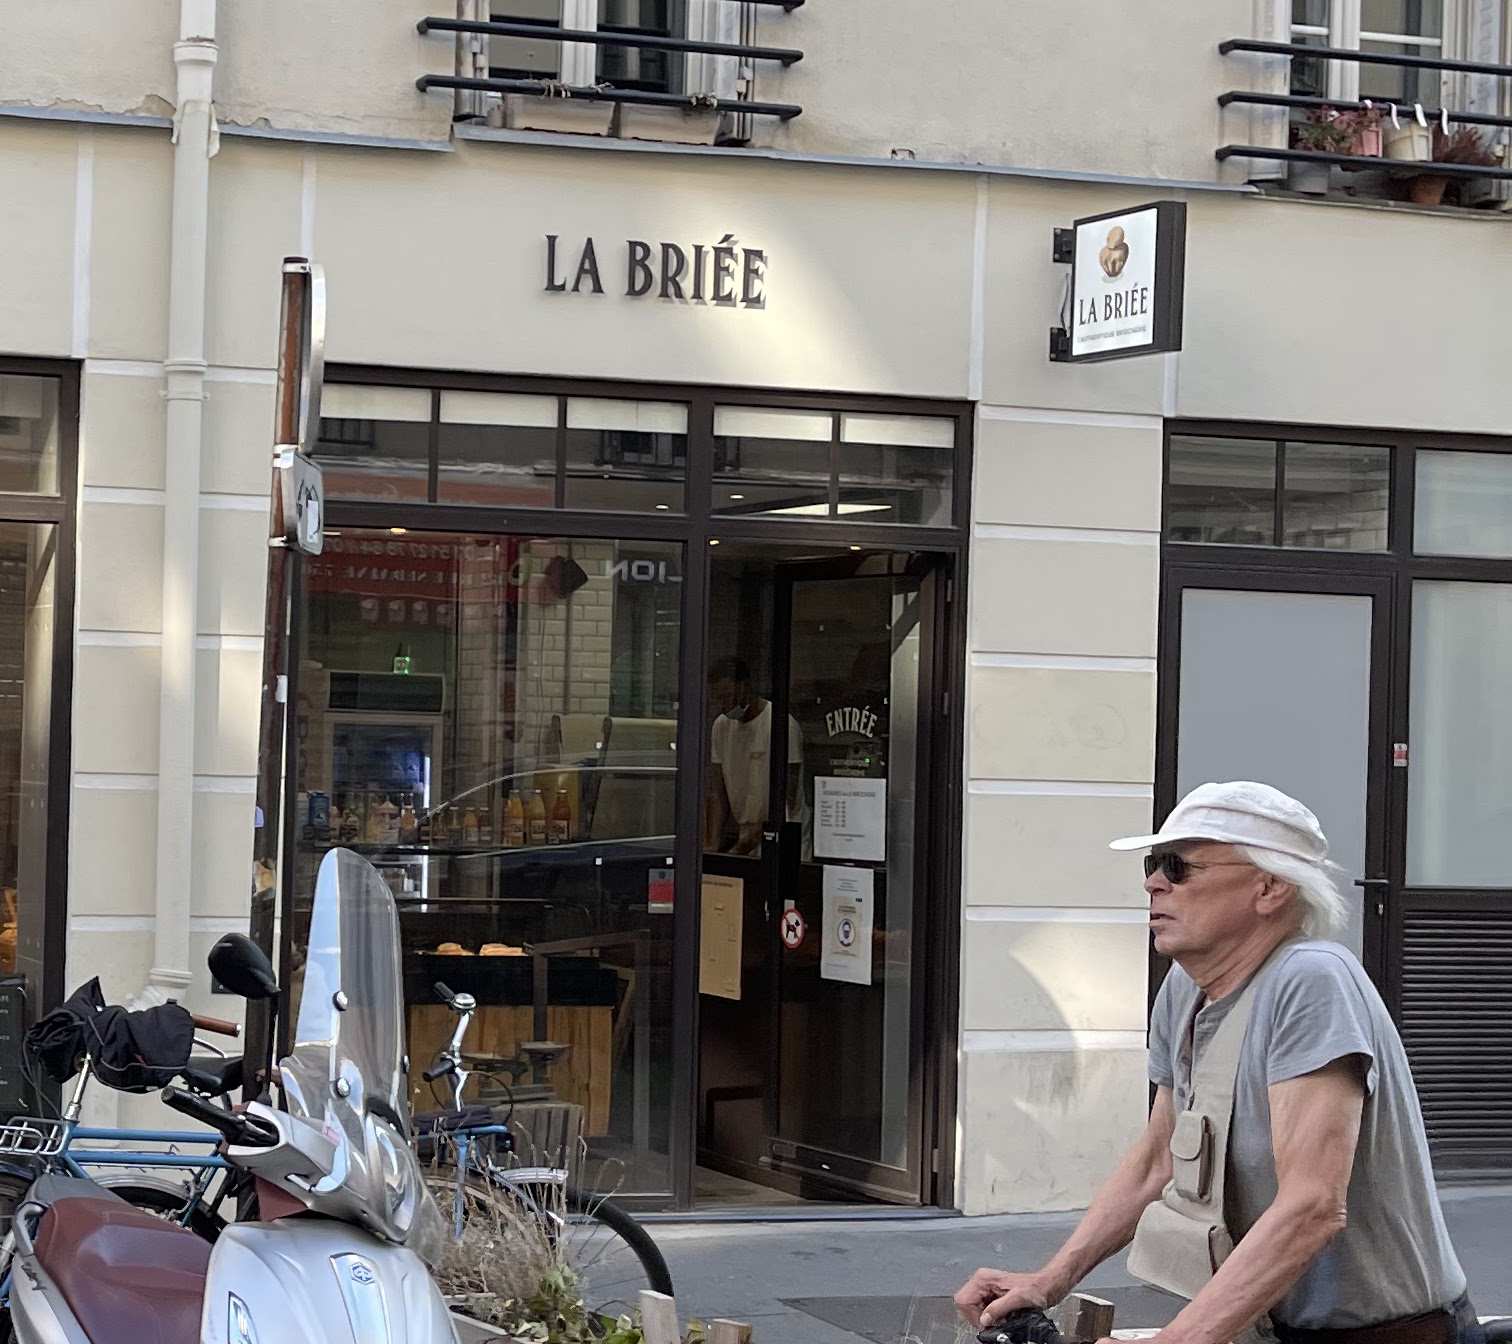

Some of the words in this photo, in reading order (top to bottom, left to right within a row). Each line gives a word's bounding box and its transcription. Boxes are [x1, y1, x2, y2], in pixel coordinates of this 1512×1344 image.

[544, 234, 605, 294] LA
[625, 233, 765, 305] BRIÉE
[1078, 297, 1098, 326] LA
[1103, 282, 1149, 322] BRIÉE
[824, 705, 878, 739] ENTRÉE
